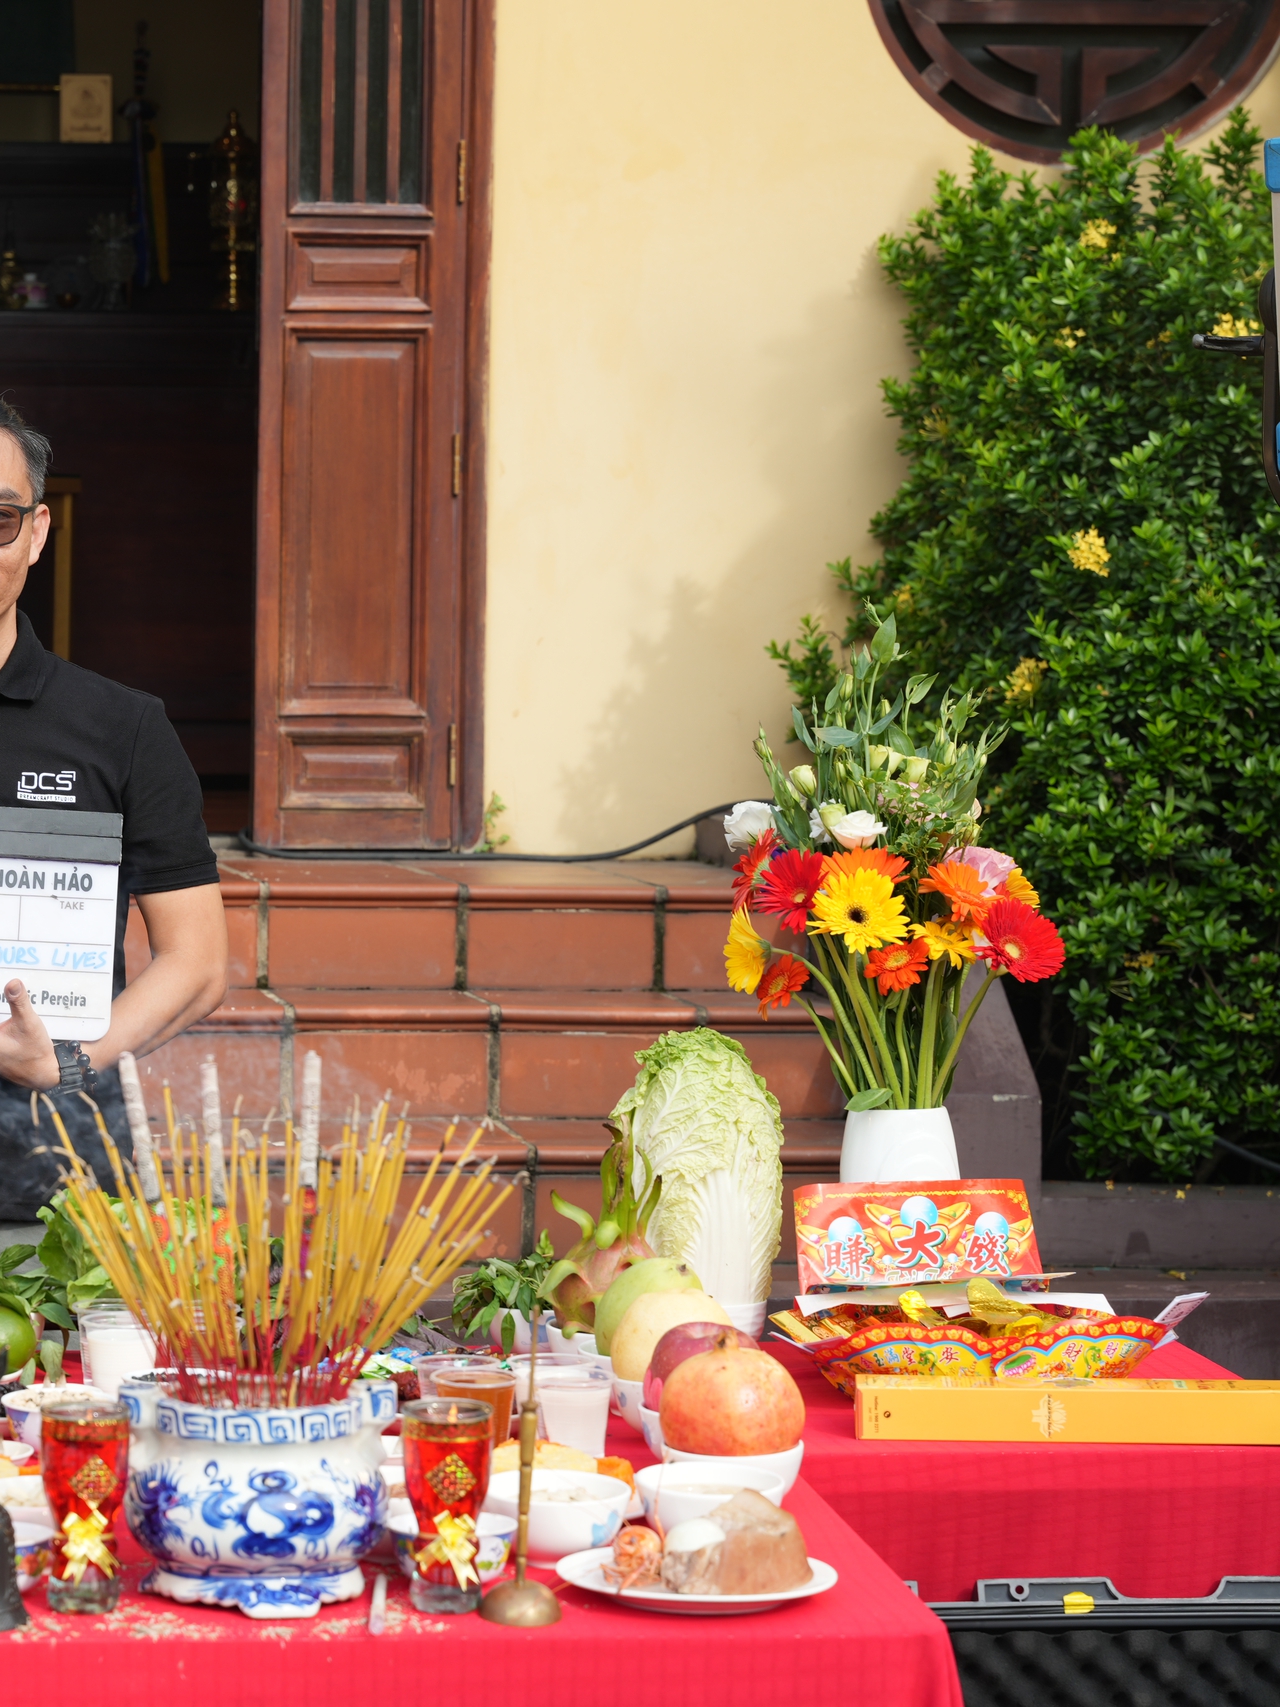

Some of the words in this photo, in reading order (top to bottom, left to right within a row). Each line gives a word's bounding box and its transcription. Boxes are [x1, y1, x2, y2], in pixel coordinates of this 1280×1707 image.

[19, 771, 75, 791] DCS
[53, 866, 93, 892] HẢO
[60, 900, 84, 910] TAKE
[41, 990, 86, 1007] Pereira
[823, 1219, 1011, 1278] 賺大錢
